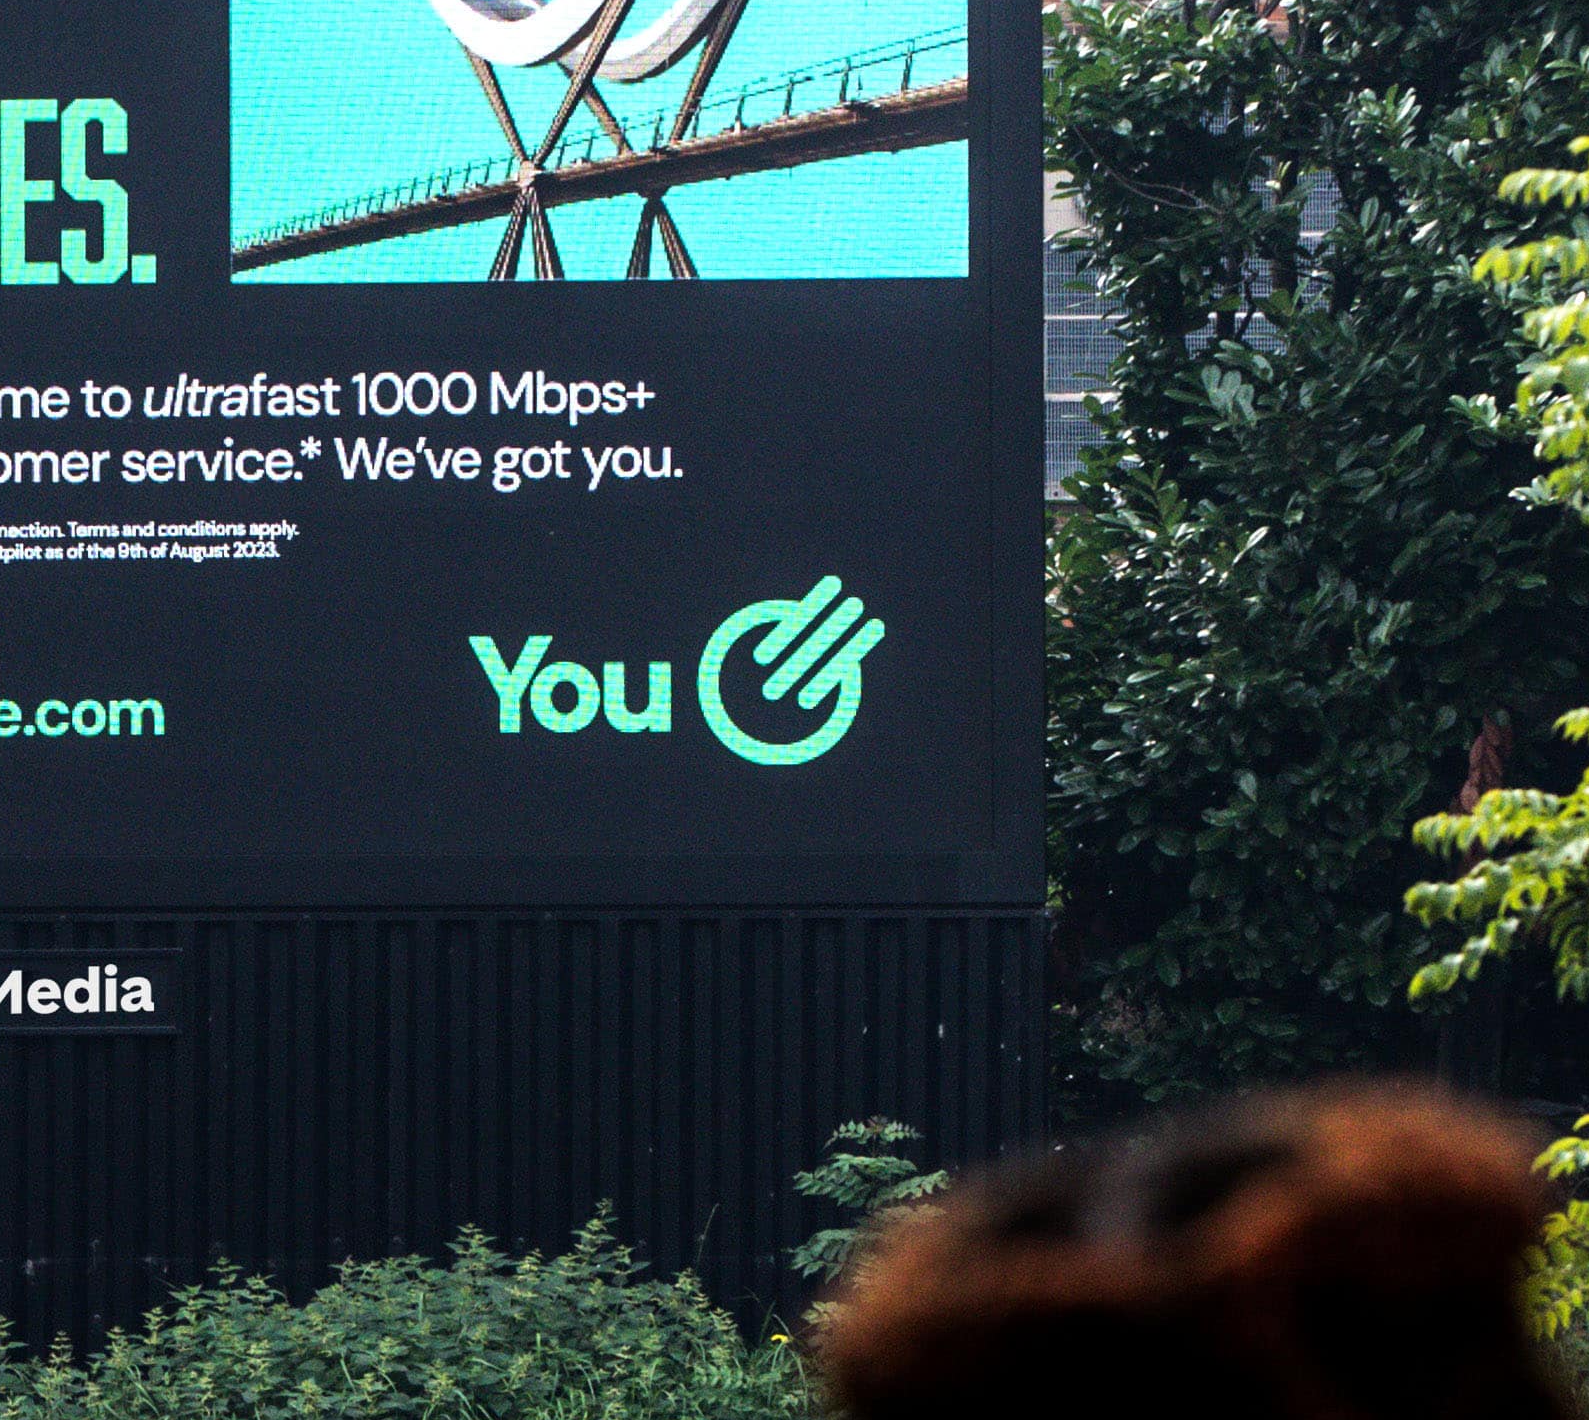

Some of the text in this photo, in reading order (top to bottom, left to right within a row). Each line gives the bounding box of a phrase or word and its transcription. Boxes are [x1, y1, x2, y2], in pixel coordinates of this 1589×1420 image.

[81, 380, 133, 421] to
[144, 373, 341, 421] ultrafast
[352, 374, 478, 418] 1000
[490, 371, 656, 429] Mbps+
[335, 437, 482, 483] We've
[493, 441, 572, 495] got
[583, 444, 684, 493] you.
[45, 547, 64, 561] as
[67, 544, 85, 560] of
[86, 543, 116, 560] the
[118, 543, 148, 560] 9th
[150, 543, 169, 559] of
[170, 542, 231, 564] August
[233, 541, 281, 559] 2023.
[67, 522, 120, 537] Terms
[122, 521, 155, 536] and
[158, 520, 246, 536] conditions
[249, 520, 301, 540] apply.
[469, 635, 673, 735] You
